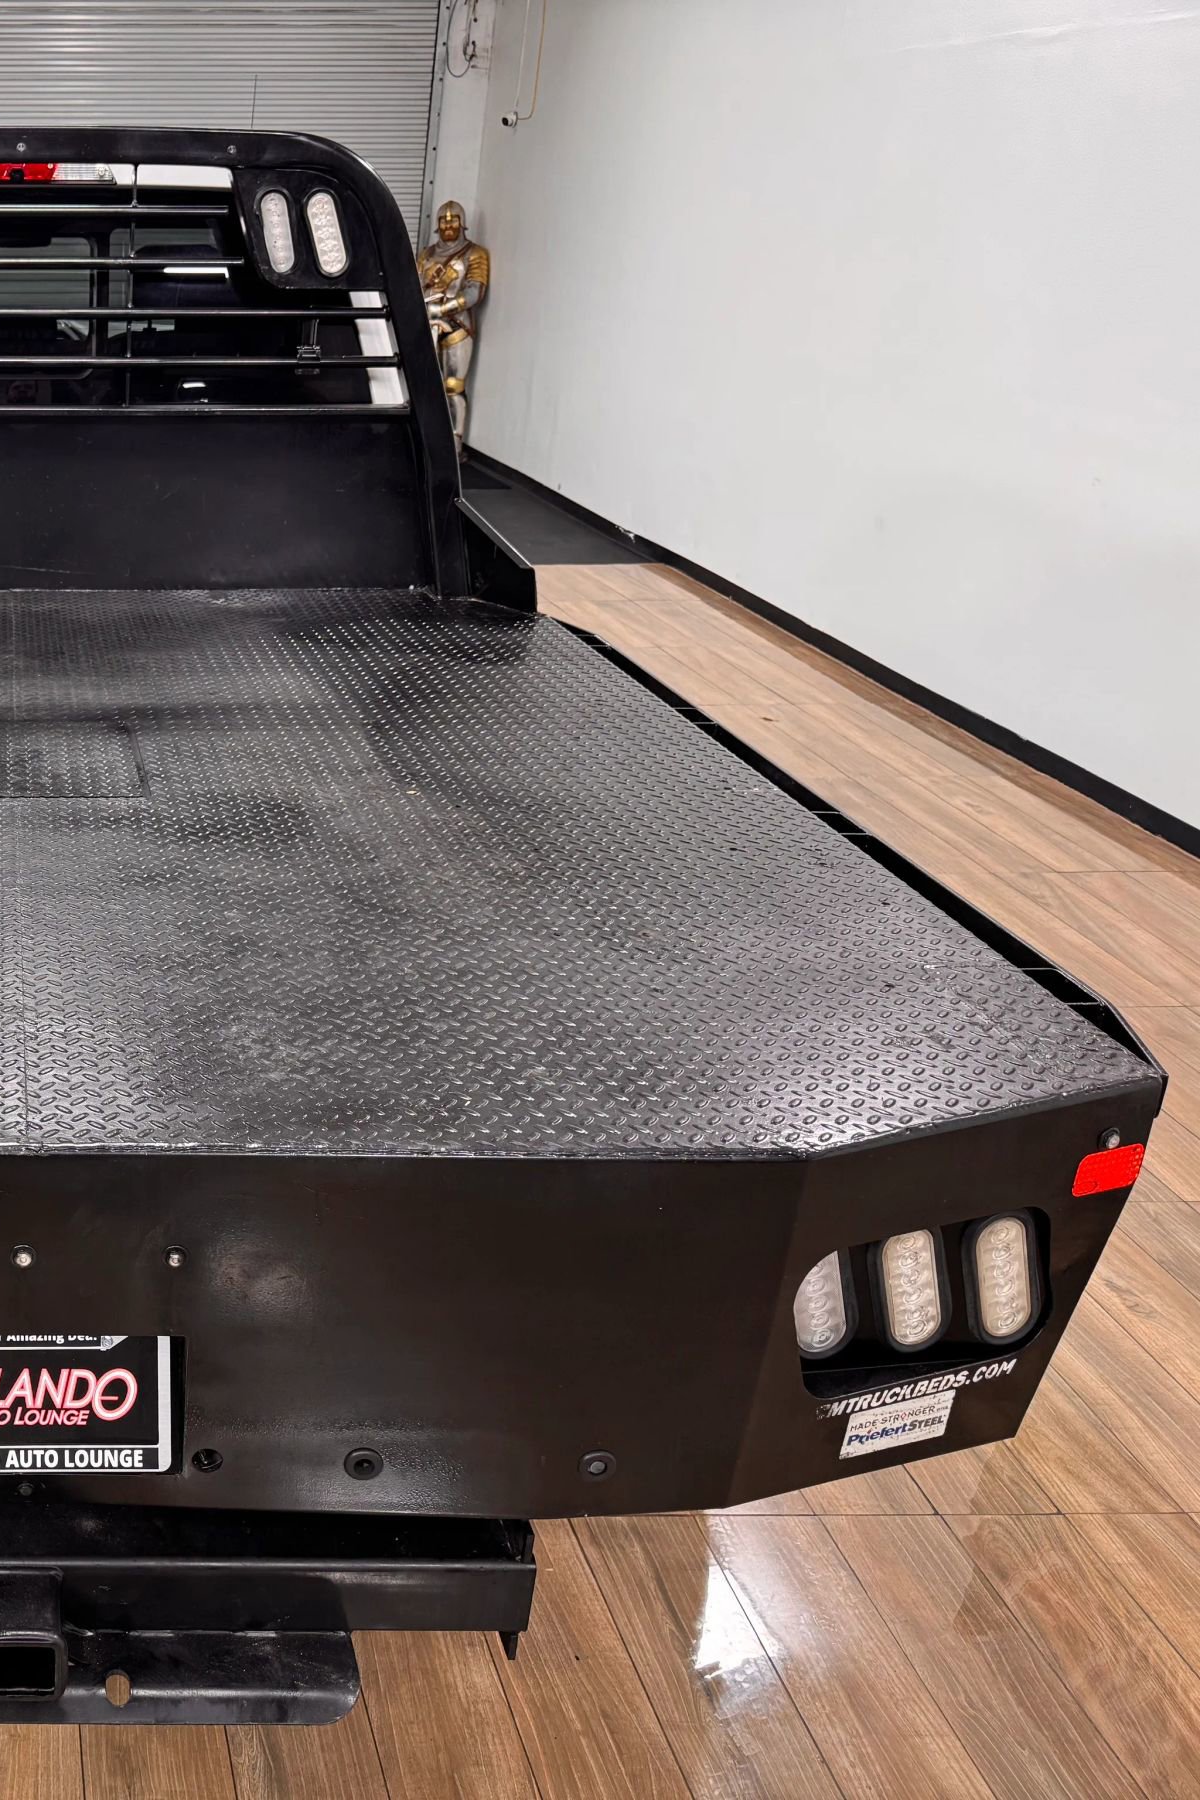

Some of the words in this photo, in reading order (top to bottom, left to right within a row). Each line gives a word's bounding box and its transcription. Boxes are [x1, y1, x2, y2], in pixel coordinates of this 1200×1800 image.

[14, 1406, 90, 1426] LOUNGE
[850, 1419, 879, 1432] MADE
[880, 1405, 936, 1425] STRONGER
[5, 1449, 60, 1469] AUTO
[64, 1449, 144, 1469] LOUNGE
